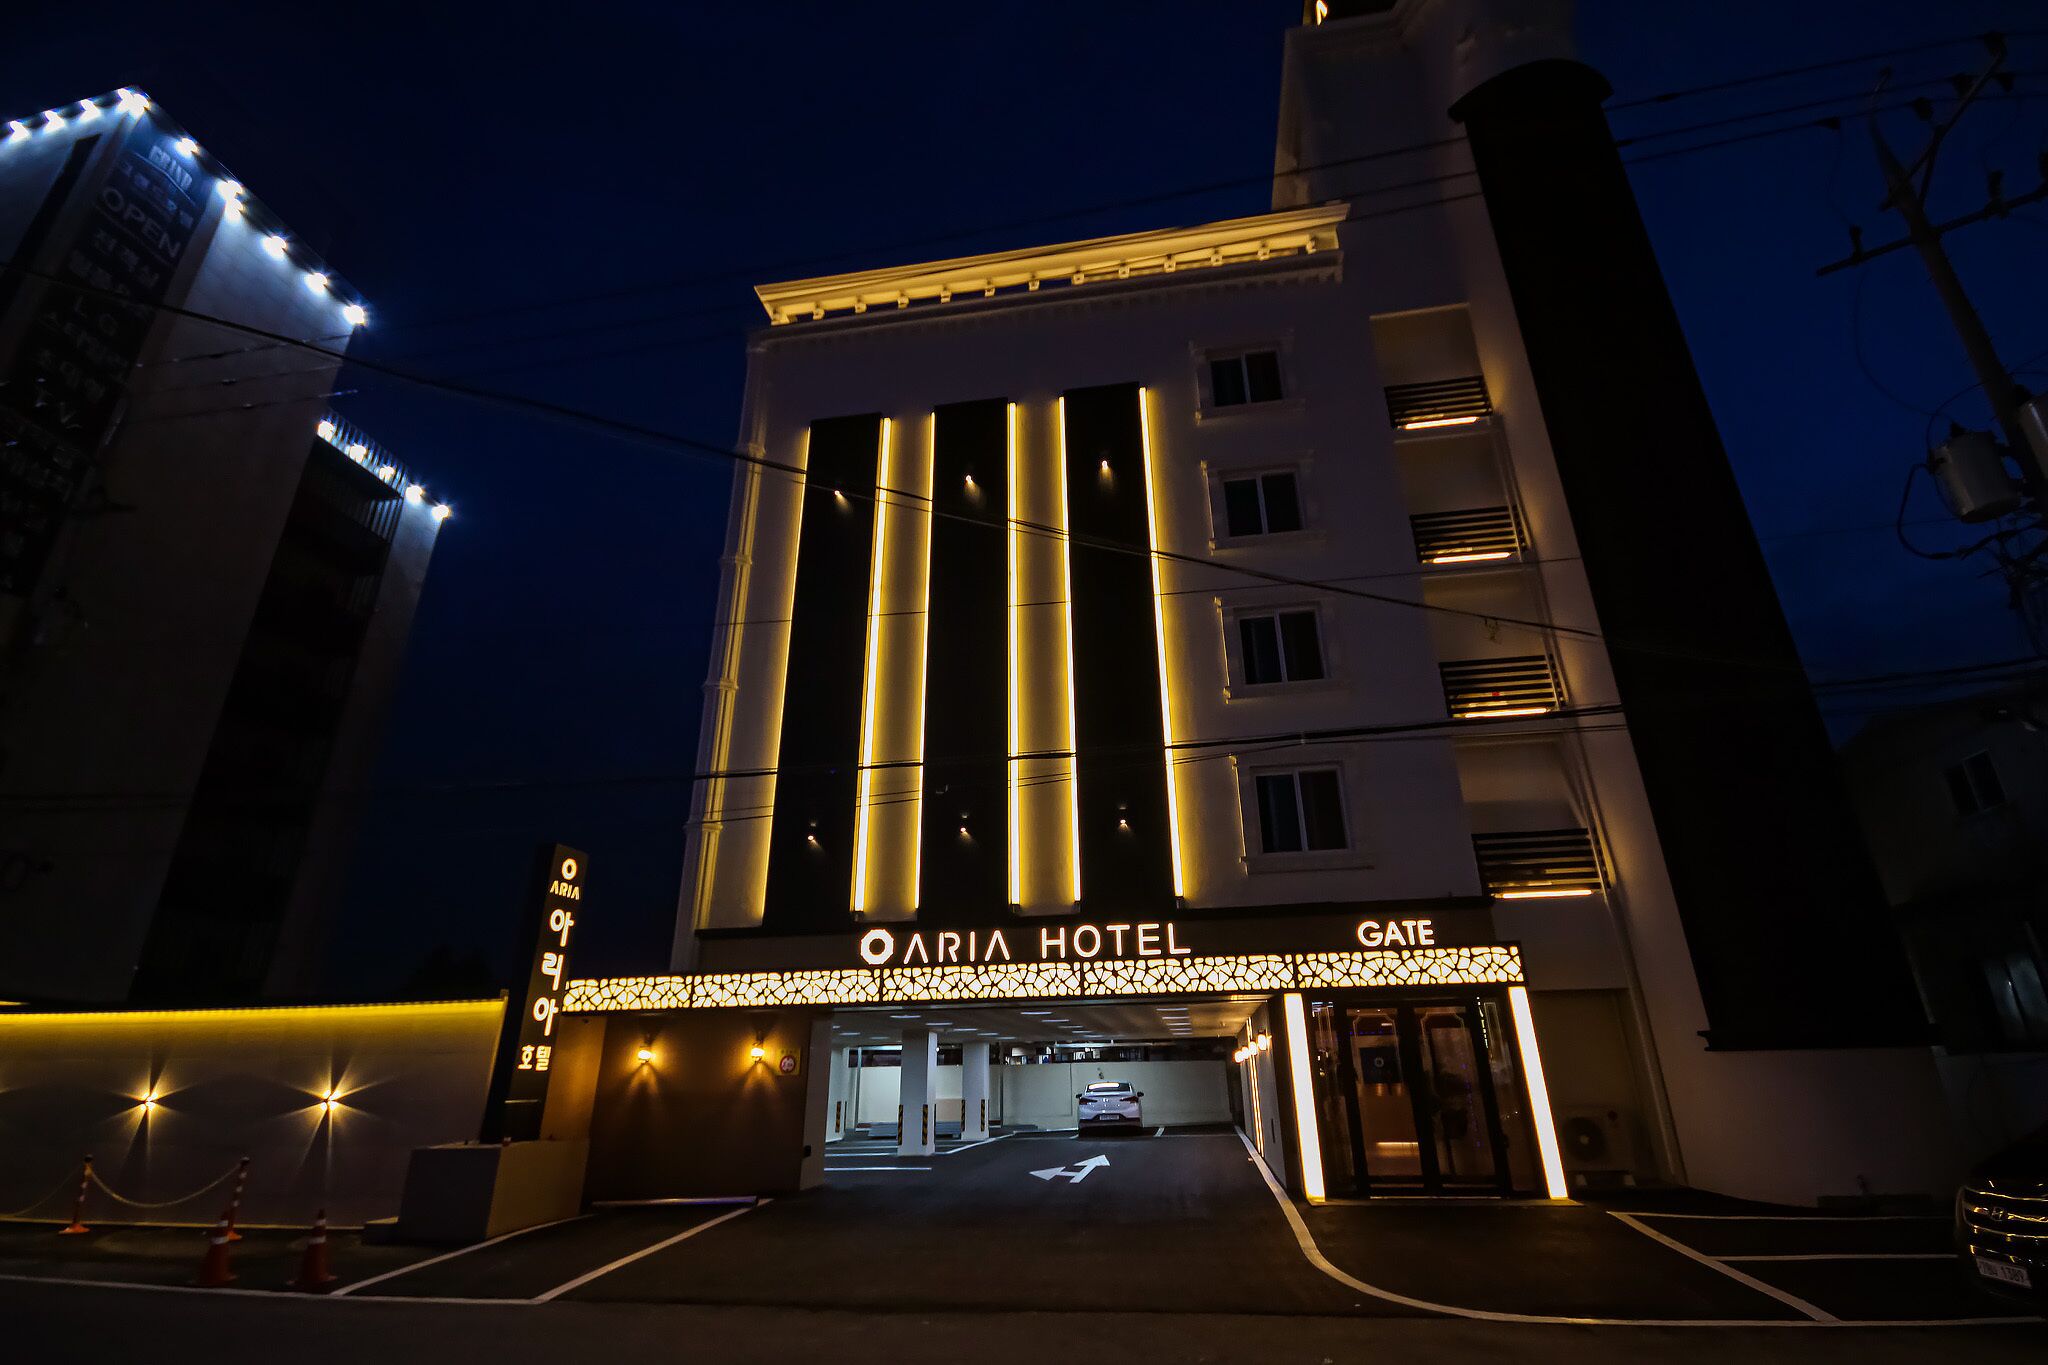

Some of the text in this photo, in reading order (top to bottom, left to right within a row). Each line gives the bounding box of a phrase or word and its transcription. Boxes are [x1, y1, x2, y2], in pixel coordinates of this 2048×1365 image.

[102, 186, 181, 259] OPEN
[550, 880, 580, 901] ARIA
[903, 922, 1192, 964] ARIA HOTEL
[1357, 919, 1435, 947] GATE
[533, 908, 575, 1037] 아리아
[517, 1044, 552, 1072] 호텔
